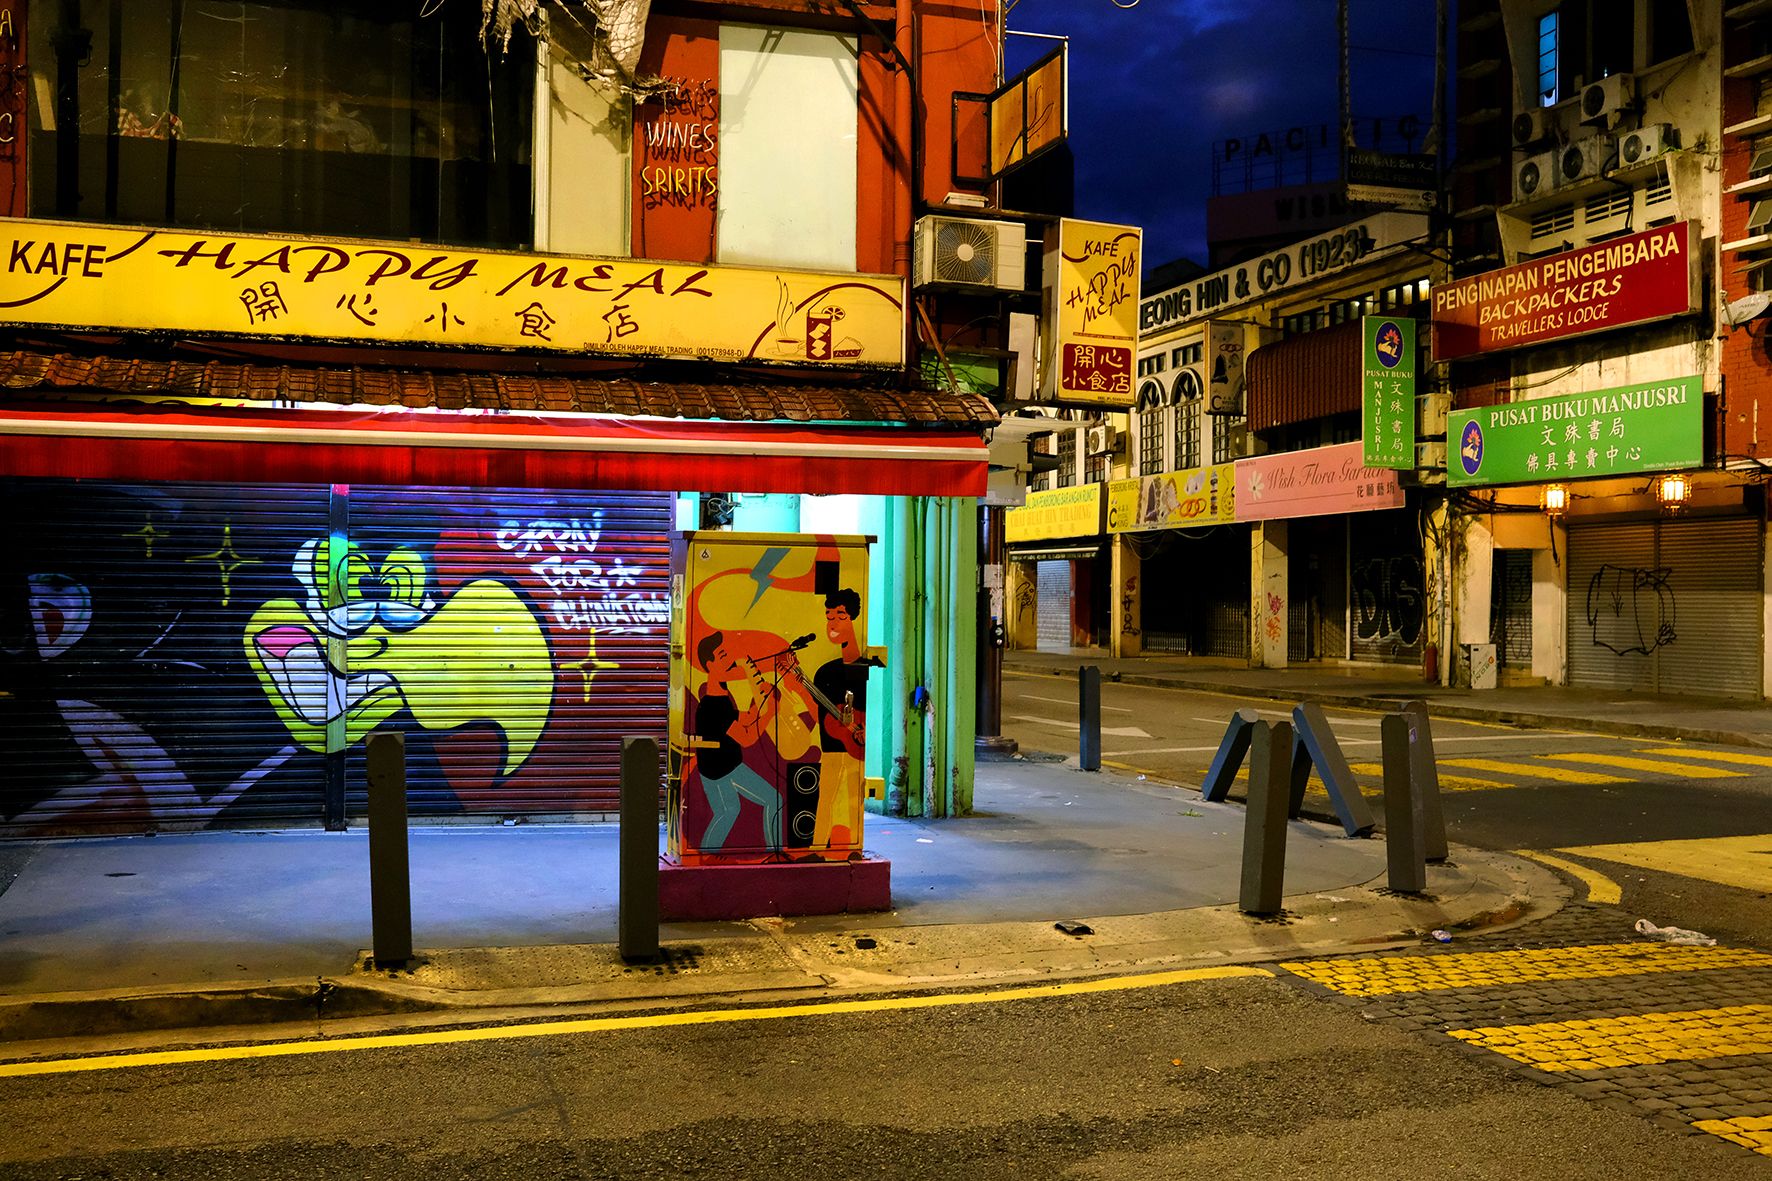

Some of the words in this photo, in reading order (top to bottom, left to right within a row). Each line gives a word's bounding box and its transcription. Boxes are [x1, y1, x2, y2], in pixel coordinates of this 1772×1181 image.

[647, 120, 715, 152] WINES
[1224, 114, 1420, 162] PACIIC
[641, 165, 717, 196] SPIRITS
[8, 240, 107, 278] KAFE
[1083, 240, 1119, 257] KAFE
[1197, 274, 1228, 312] HIN
[1235, 267, 1250, 299] &
[1257, 252, 1292, 292] CO
[1300, 224, 1371, 278] (1923)
[157, 240, 478, 290] HAPPY
[495, 261, 713, 302] MEAL
[1065, 251, 1136, 309] HAPPY
[1436, 266, 1538, 312] PENGINAPAN
[1543, 231, 1680, 286] PENGEMBARA
[239, 281, 639, 343] 開心小食店
[1082, 282, 1131, 333] MEAL
[1479, 274, 1623, 325] BACKPACKERS
[1490, 311, 1564, 342] TRAVELLERS
[1567, 302, 1609, 326] LODGE
[610, 343, 626, 351] OLEH
[627, 344, 648, 353] HAPPY
[649, 345, 666, 353] MEAL
[667, 346, 693, 354] TRADING
[1073, 345, 1124, 369] 開心
[1063, 369, 1130, 393] 小食店
[1365, 370, 1389, 378] PUSAT
[1391, 370, 1413, 379] BUKU
[1374, 381, 1383, 452] MANJUSRI
[1390, 381, 1405, 452] 文殊書局
[1489, 406, 1538, 429] PUSAT
[1541, 399, 1589, 422] BUKU
[1592, 384, 1688, 415] MANJUSRI
[1540, 416, 1626, 447] 文殊書局
[1266, 464, 1295, 490] Wish
[1298, 463, 1336, 488] Flora
[1525, 445, 1642, 475] 佛具專賣中心
